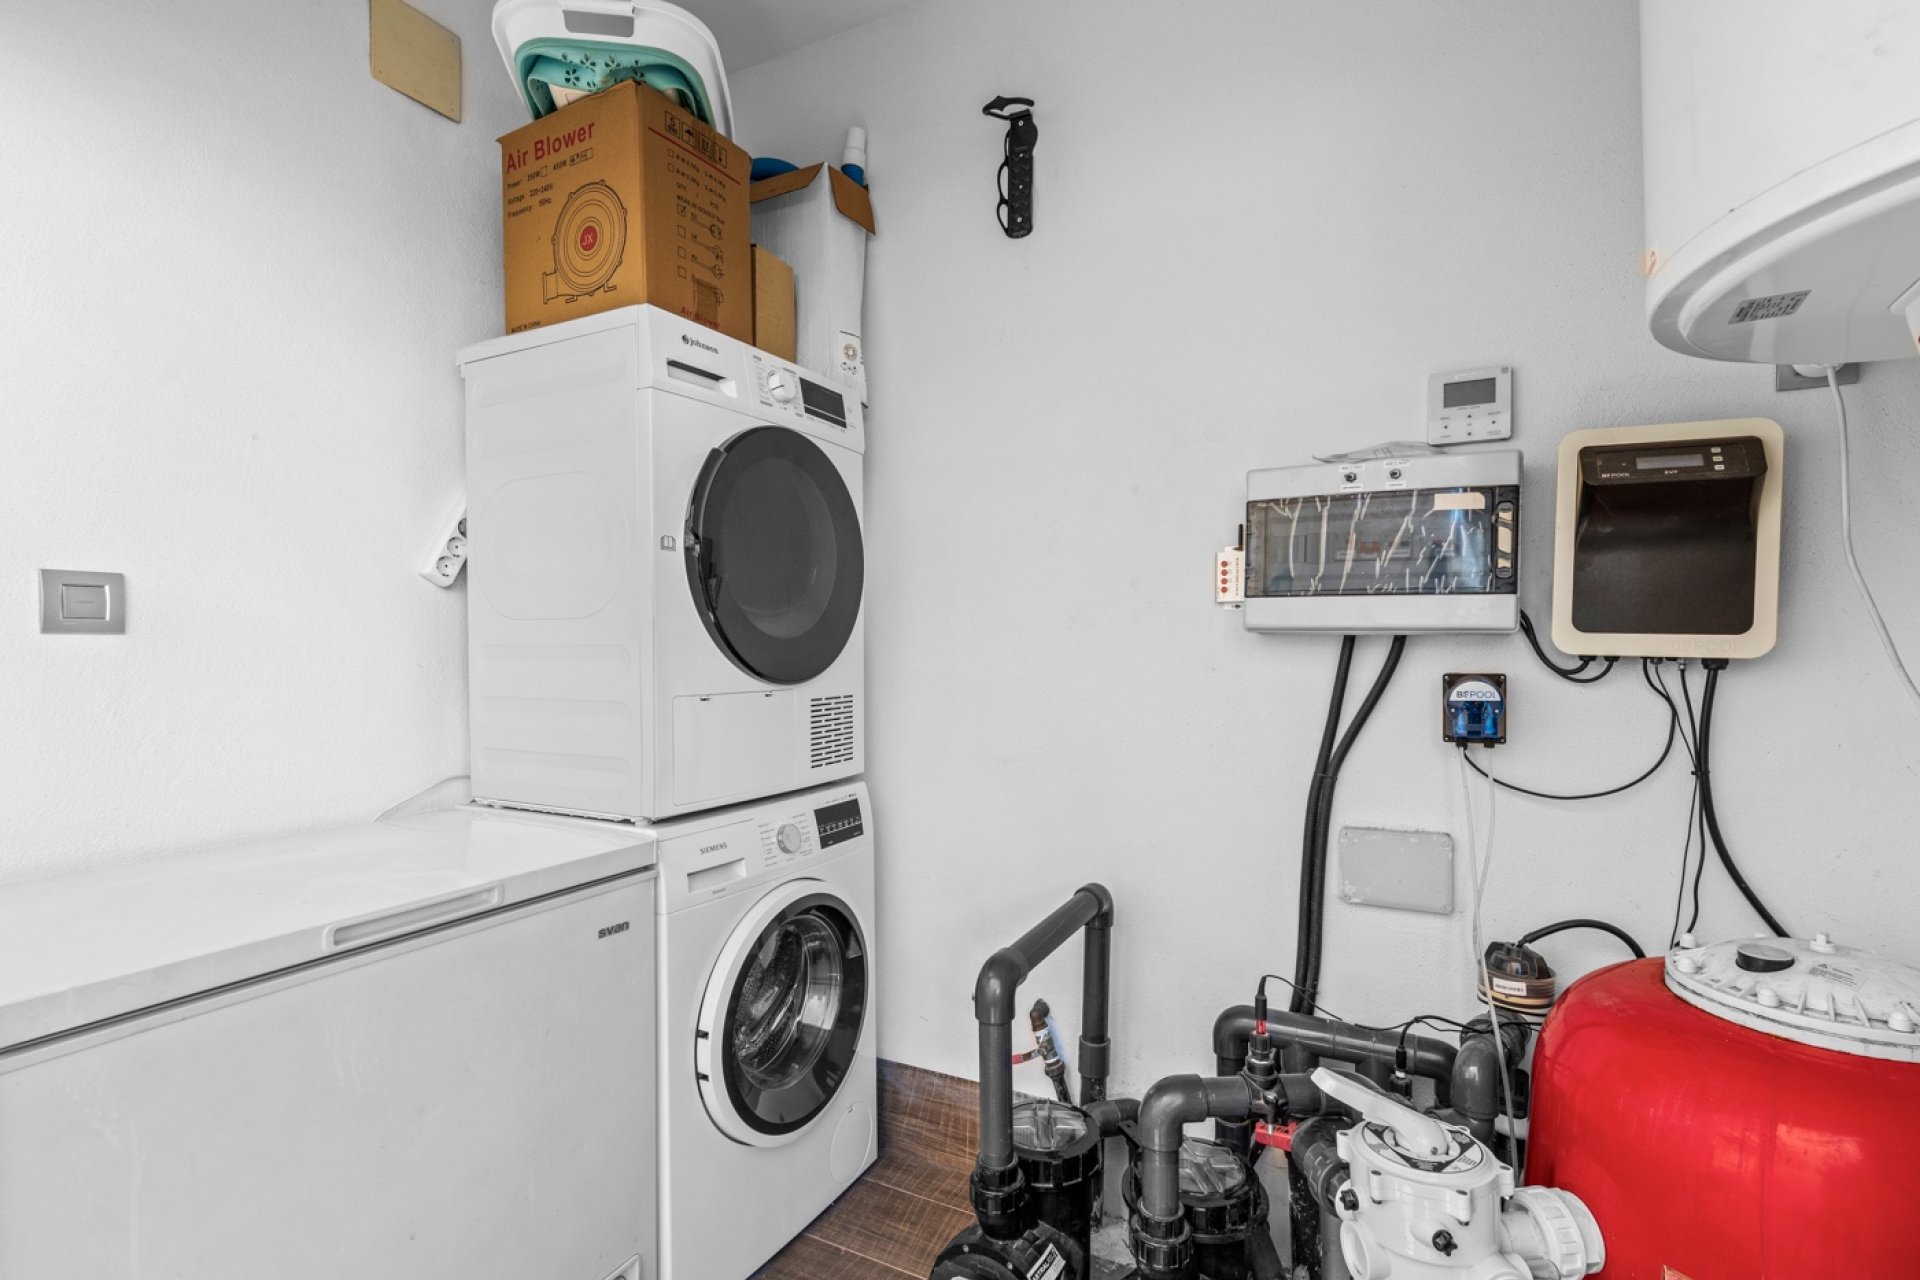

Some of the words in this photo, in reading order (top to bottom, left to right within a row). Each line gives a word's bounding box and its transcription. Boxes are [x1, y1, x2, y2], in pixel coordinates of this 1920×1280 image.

[506, 148, 529, 174] Air
[534, 122, 595, 160] Blower
[690, 337, 719, 354] johnson
[699, 842, 728, 855] SIEMENS
[598, 921, 629, 939] svan
